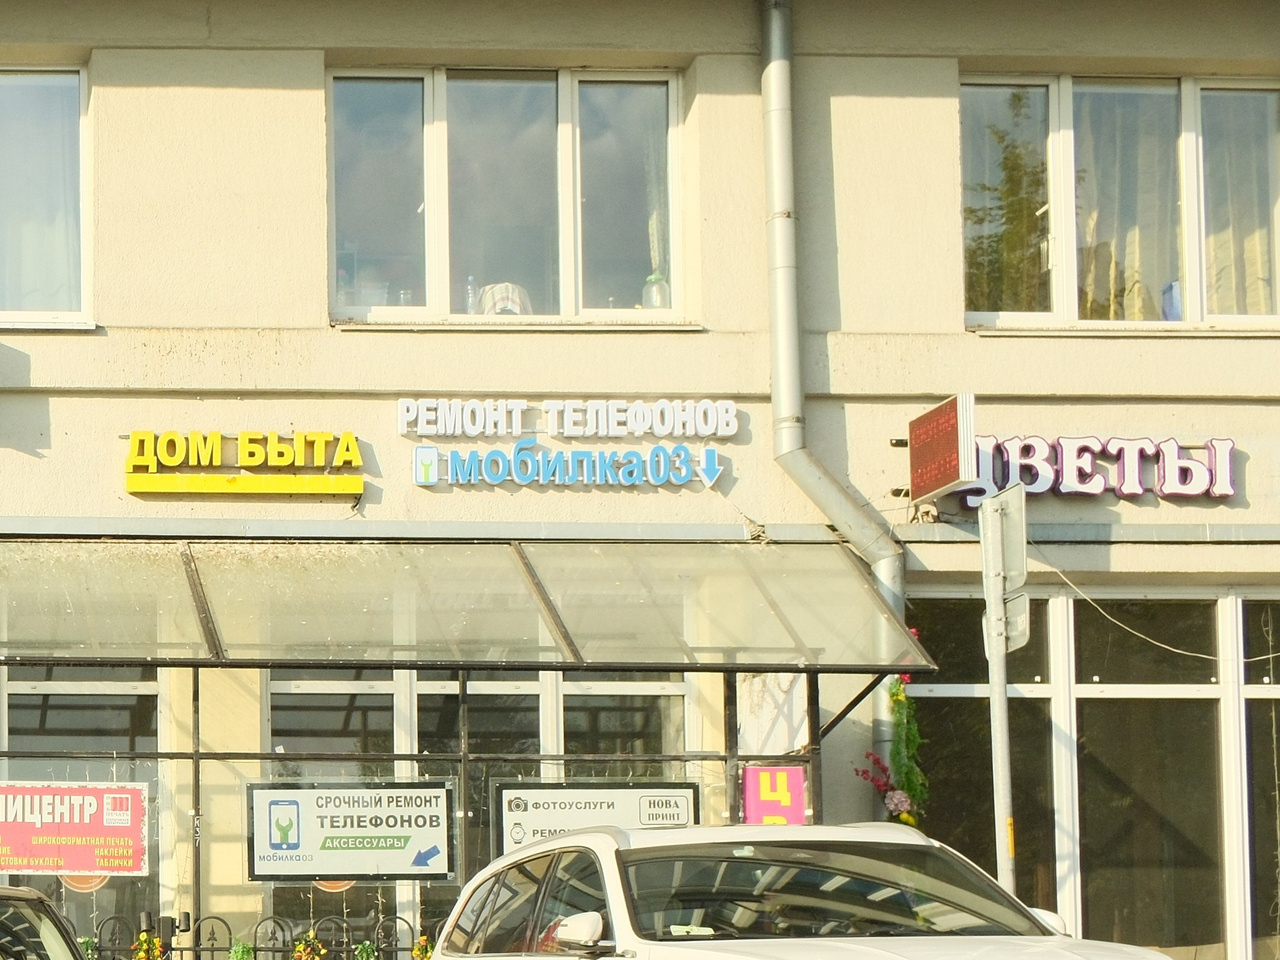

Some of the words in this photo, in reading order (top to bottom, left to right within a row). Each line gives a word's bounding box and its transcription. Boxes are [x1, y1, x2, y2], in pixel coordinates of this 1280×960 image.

[398, 398, 527, 437] РЕМОНТ
[541, 399, 740, 438] ТЕЛЕФОНОВ
[125, 431, 223, 473] ДОМ
[238, 431, 364, 467] БЫТА
[447, 437, 695, 487] мобилка03
[315, 793, 383, 809] СРОЧНЫЙ
[387, 795, 441, 808] РЕМОНТ
[531, 801, 615, 810] ФОТОУСЛУГИ
[648, 799, 680, 809] НОВА
[316, 814, 441, 829] ТЕЛЕФОНОВ
[648, 813, 680, 821] ПРИНТ
[532, 829, 574, 838] РЕМО
[31, 836, 105, 846] ШИРОКОФОРМАТНАЯ
[106, 837, 133, 846] ПЕЧАТЬ
[325, 838, 405, 848] АКСЕССУАРЫ
[95, 847, 133, 857] НАКЛЕЙКИ
[29, 857, 64, 866] БУКЛЕТЫ
[95, 858, 133, 867] ТАБЛИЧКИ
